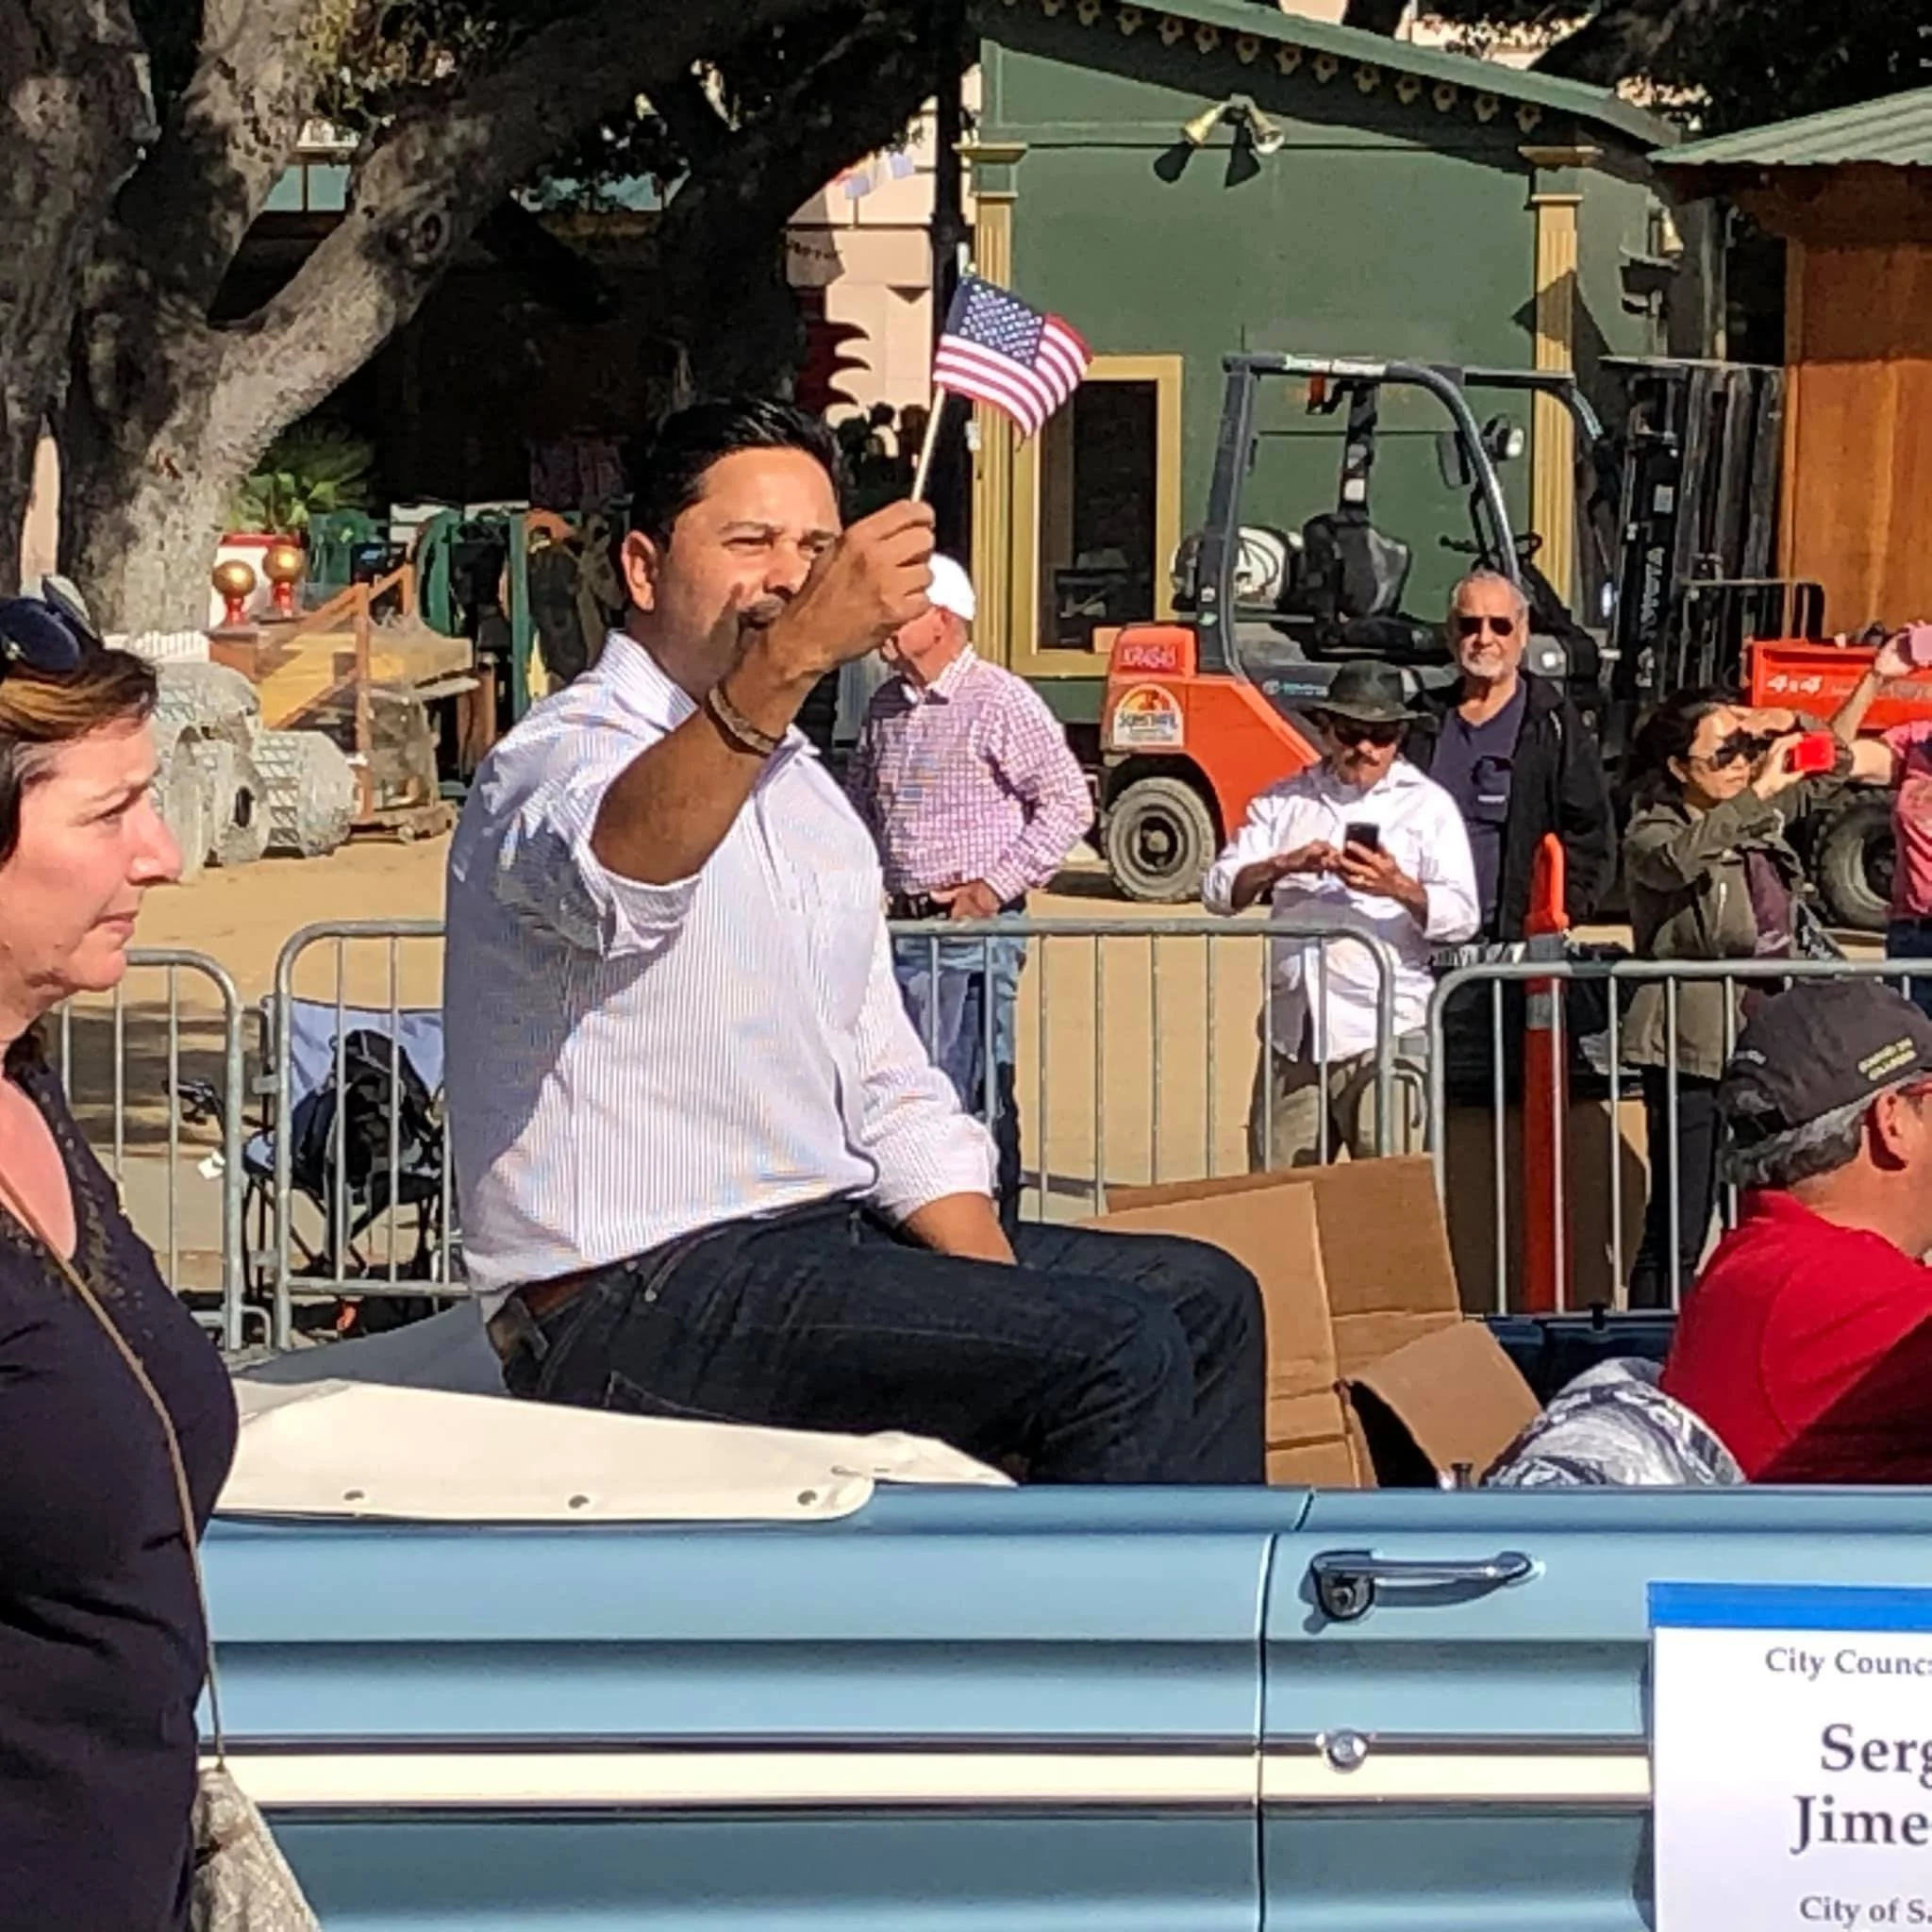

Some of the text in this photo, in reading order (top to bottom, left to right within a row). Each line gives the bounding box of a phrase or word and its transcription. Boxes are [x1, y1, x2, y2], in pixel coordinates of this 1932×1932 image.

[1765, 1647, 1825, 1681] City
[1800, 1896, 1860, 1930] City
[1869, 1896, 1900, 1924] of
